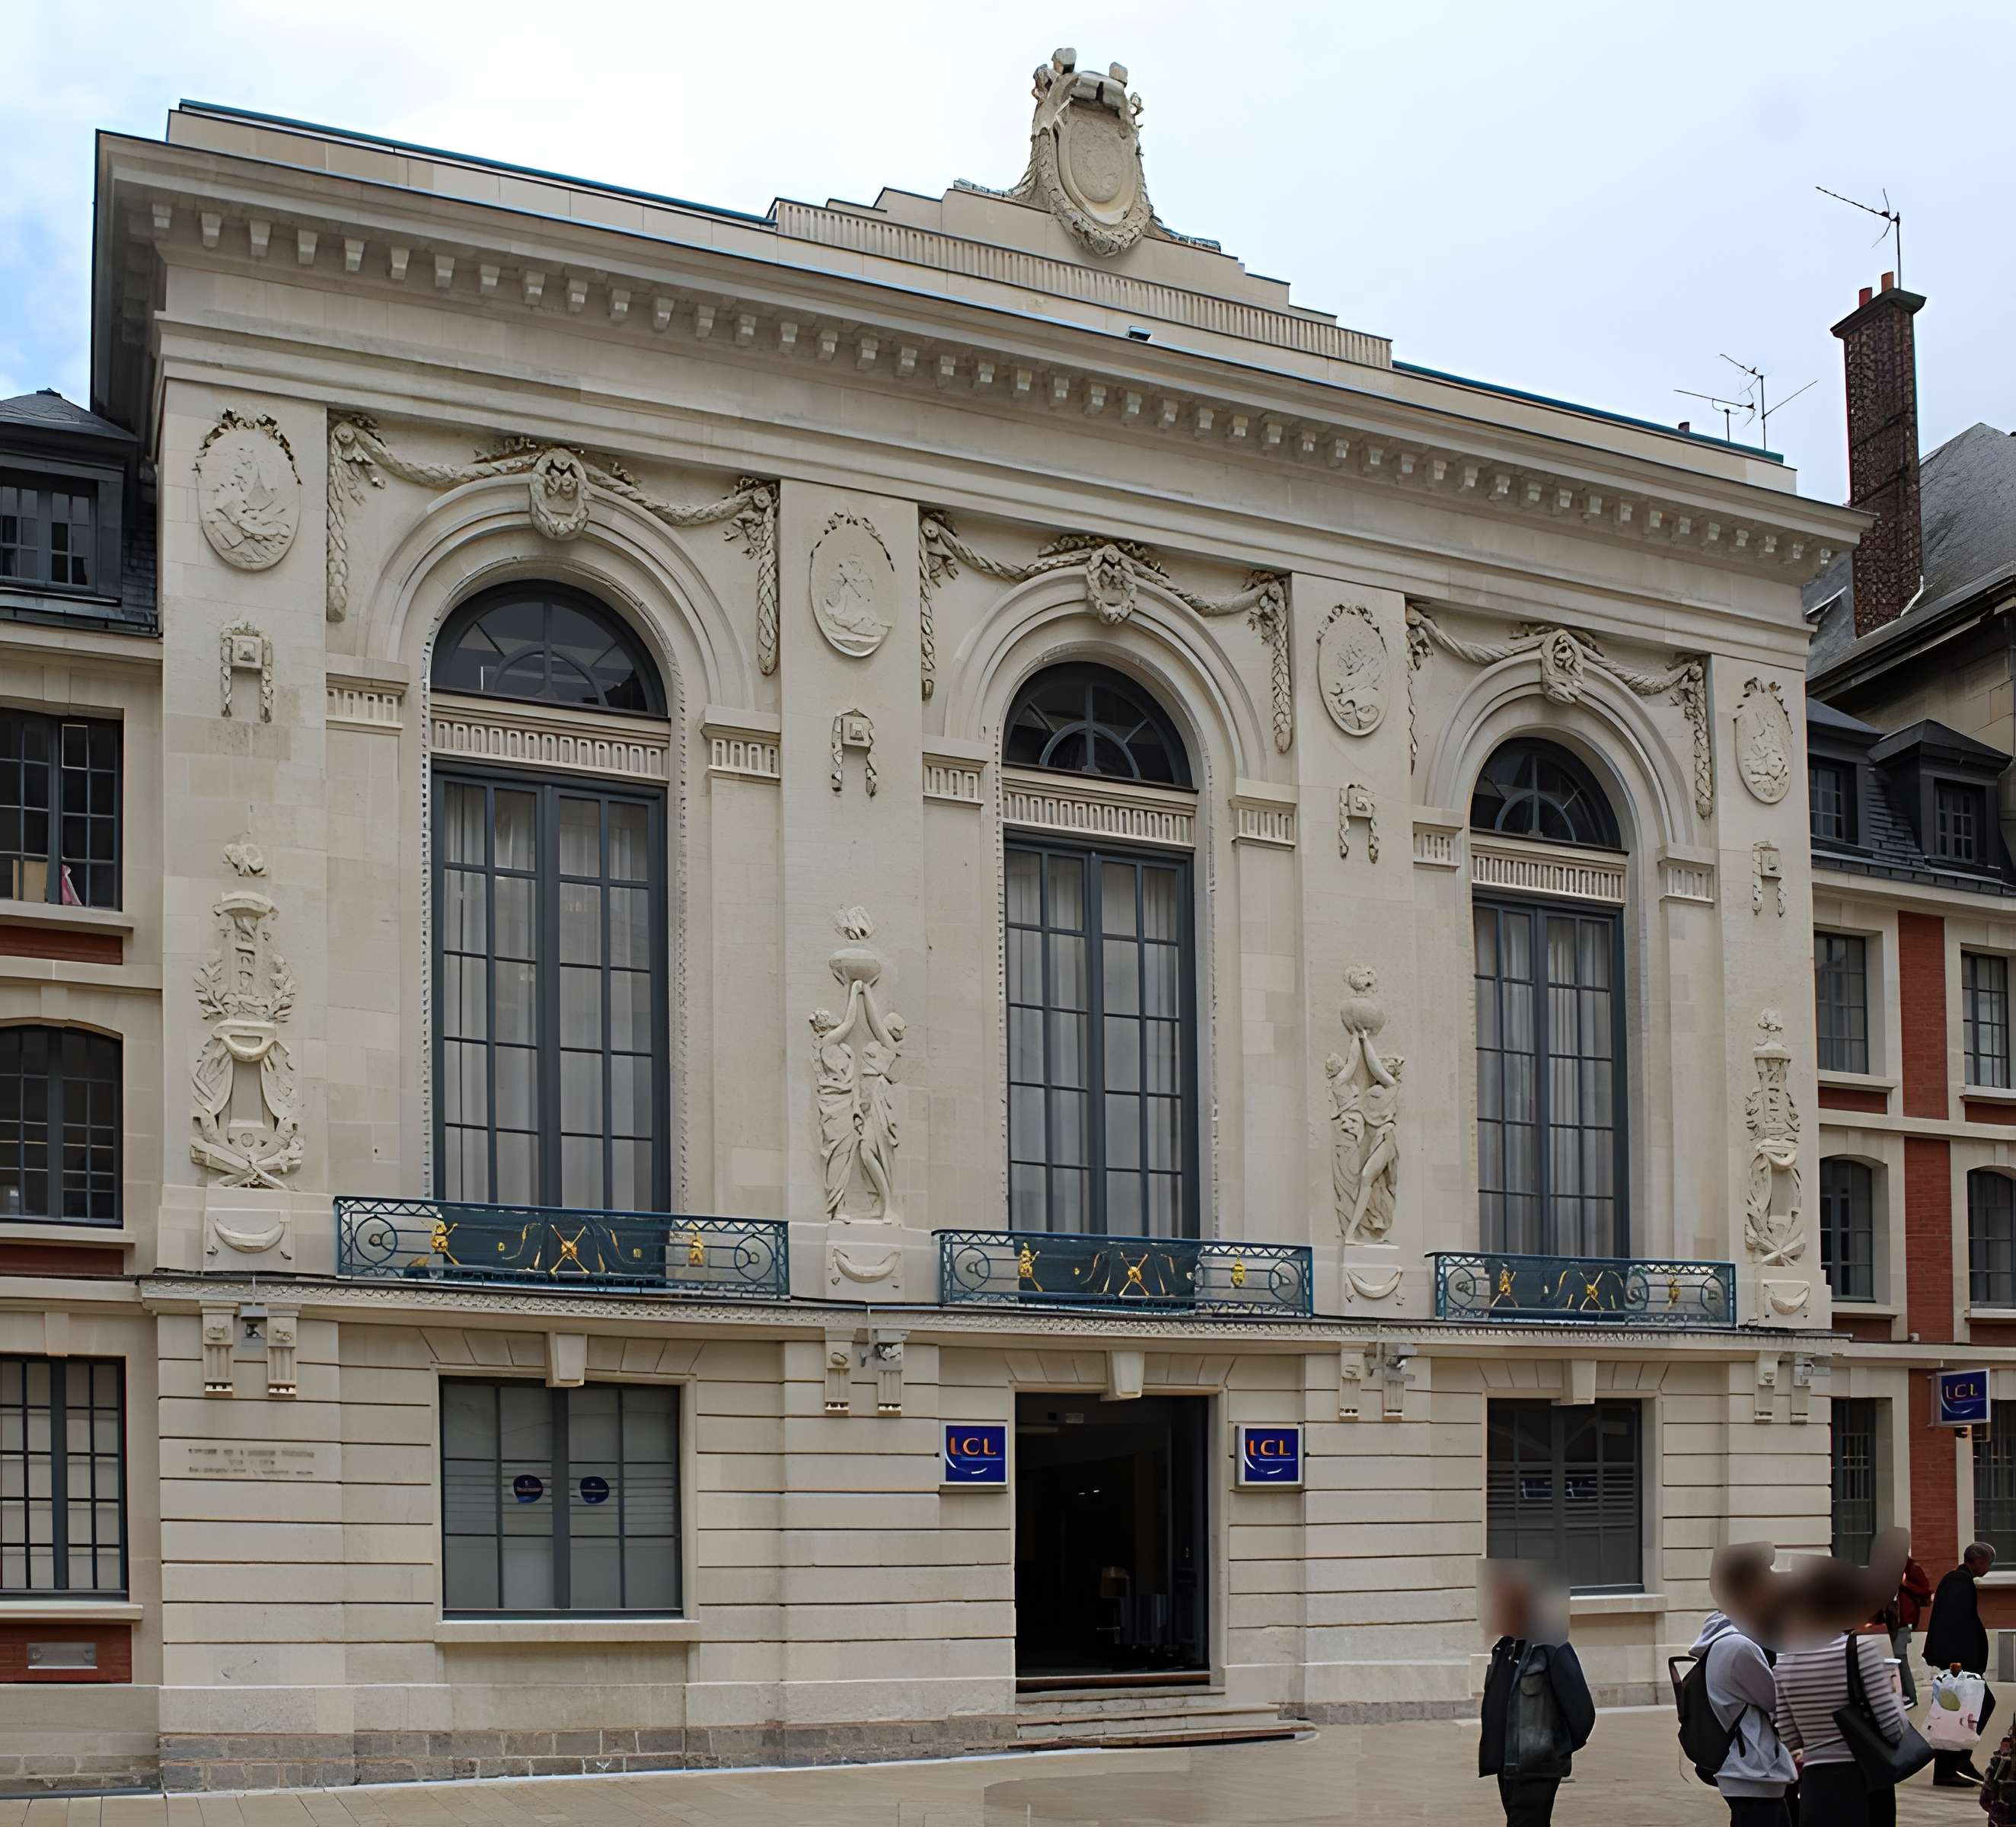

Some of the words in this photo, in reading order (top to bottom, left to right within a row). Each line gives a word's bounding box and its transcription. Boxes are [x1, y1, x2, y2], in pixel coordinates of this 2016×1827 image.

[1945, 1383, 1978, 1399] LCL
[950, 1437, 997, 1455] LCL
[1249, 1440, 1291, 1456] LCL
